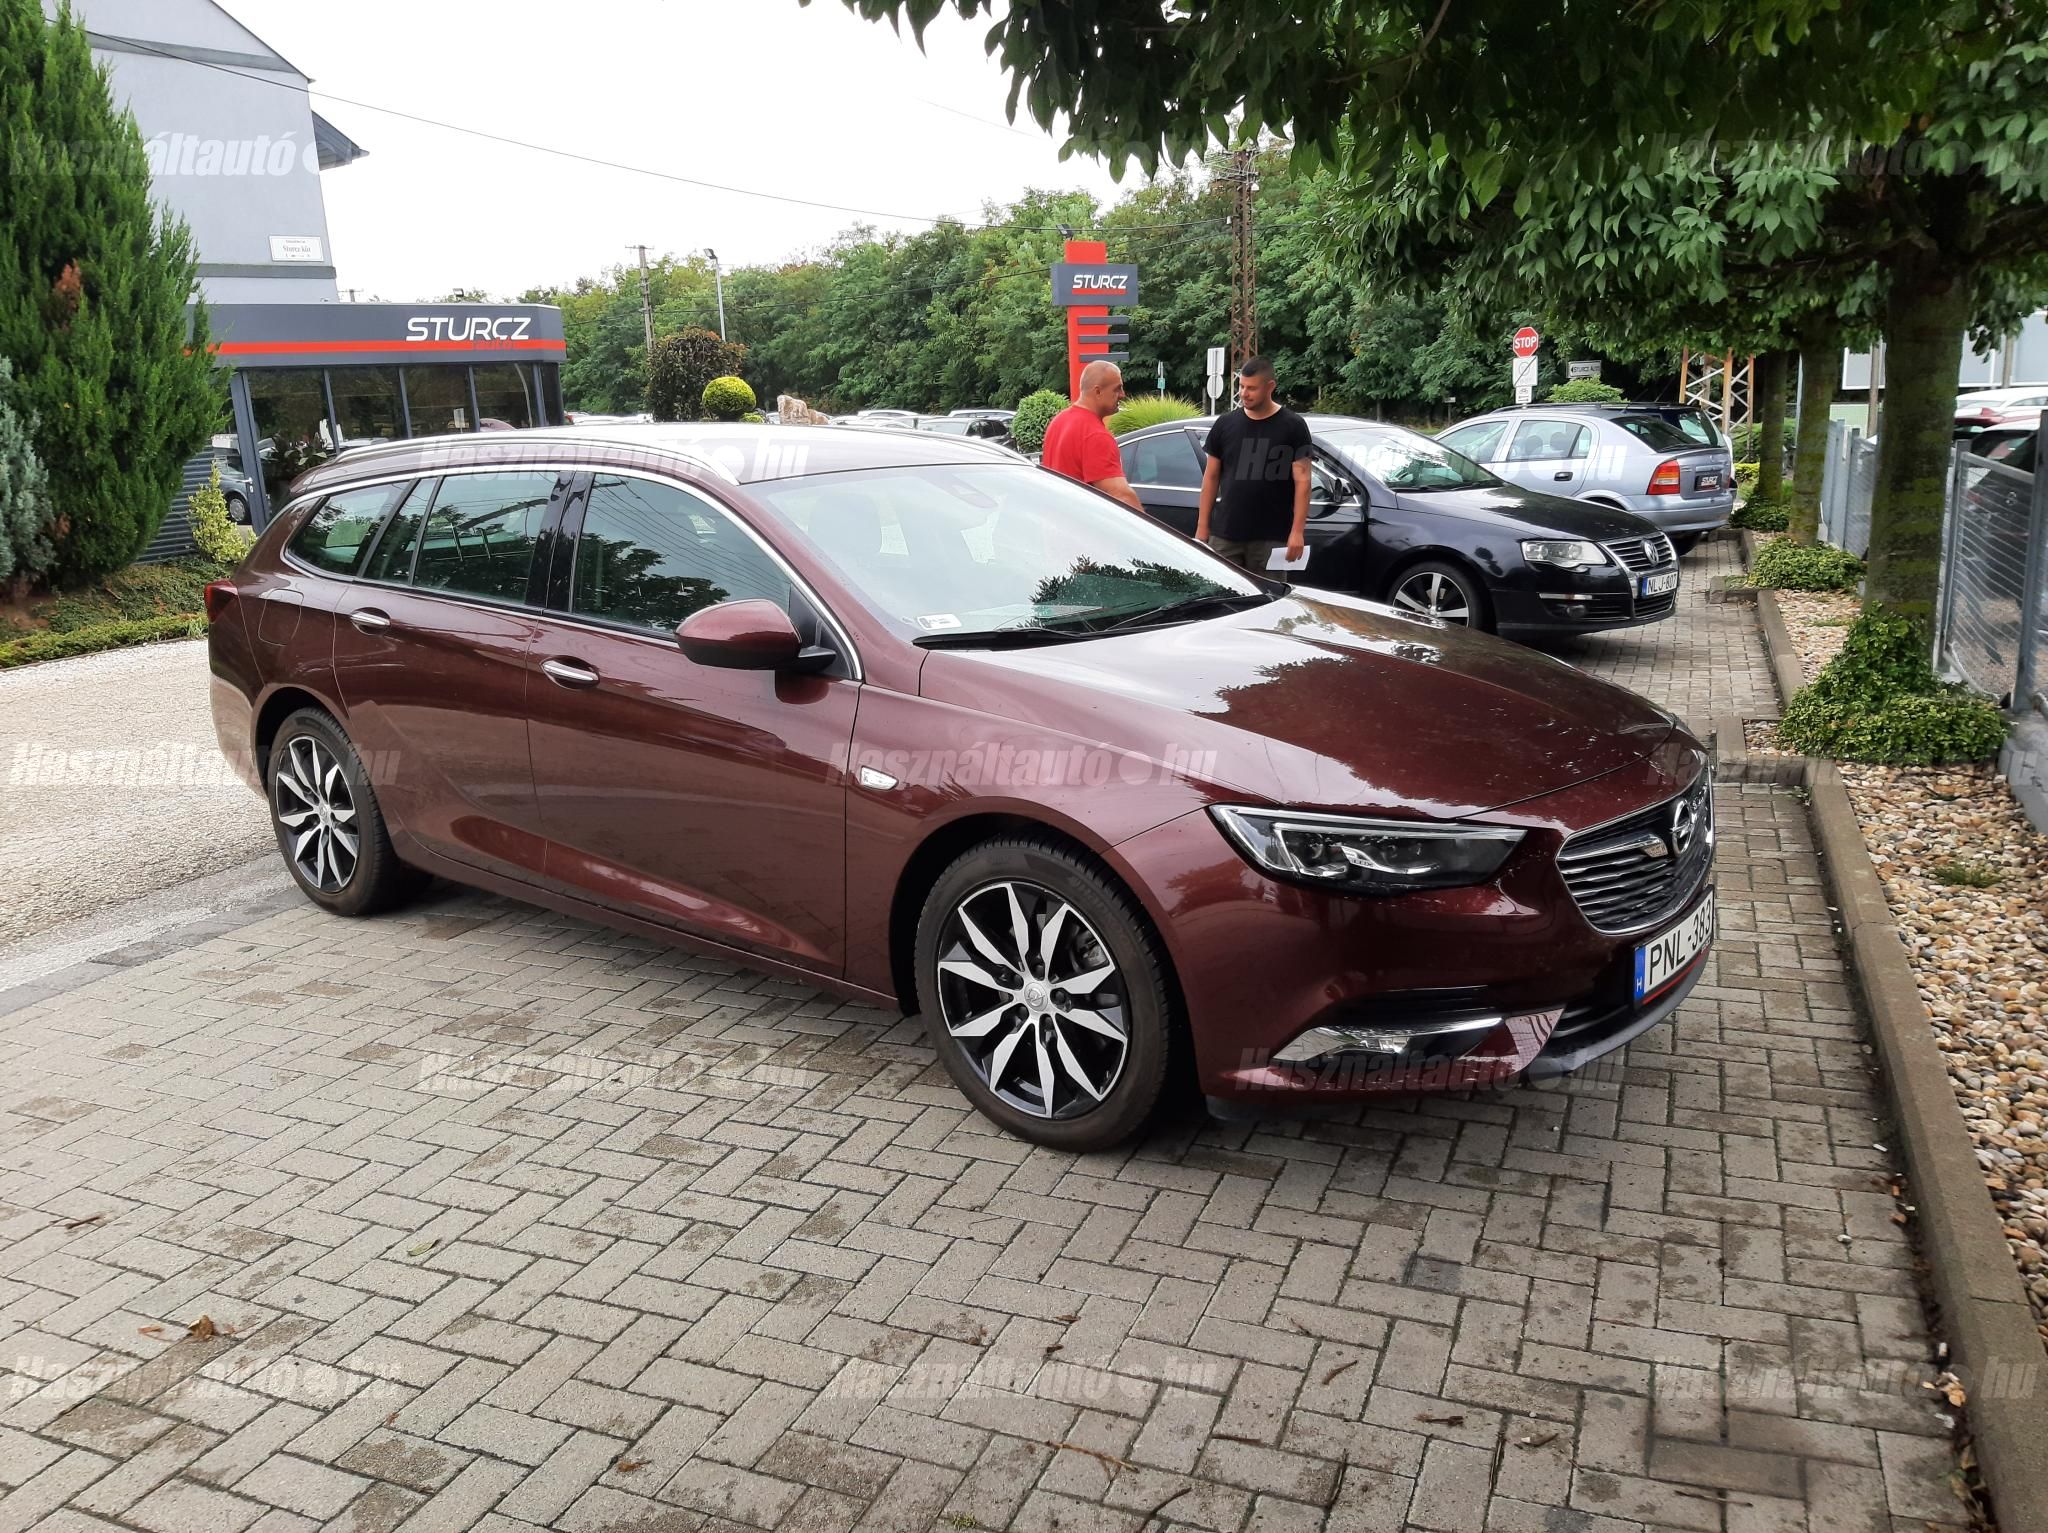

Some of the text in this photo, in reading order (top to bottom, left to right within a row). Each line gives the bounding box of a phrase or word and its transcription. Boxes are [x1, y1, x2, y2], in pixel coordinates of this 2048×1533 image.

[1072, 274, 1128, 289] STURCZ
[405, 317, 532, 341] STURCZ
[1514, 336, 1537, 349] STOP
[1636, 899, 1711, 992] H PNL-383
